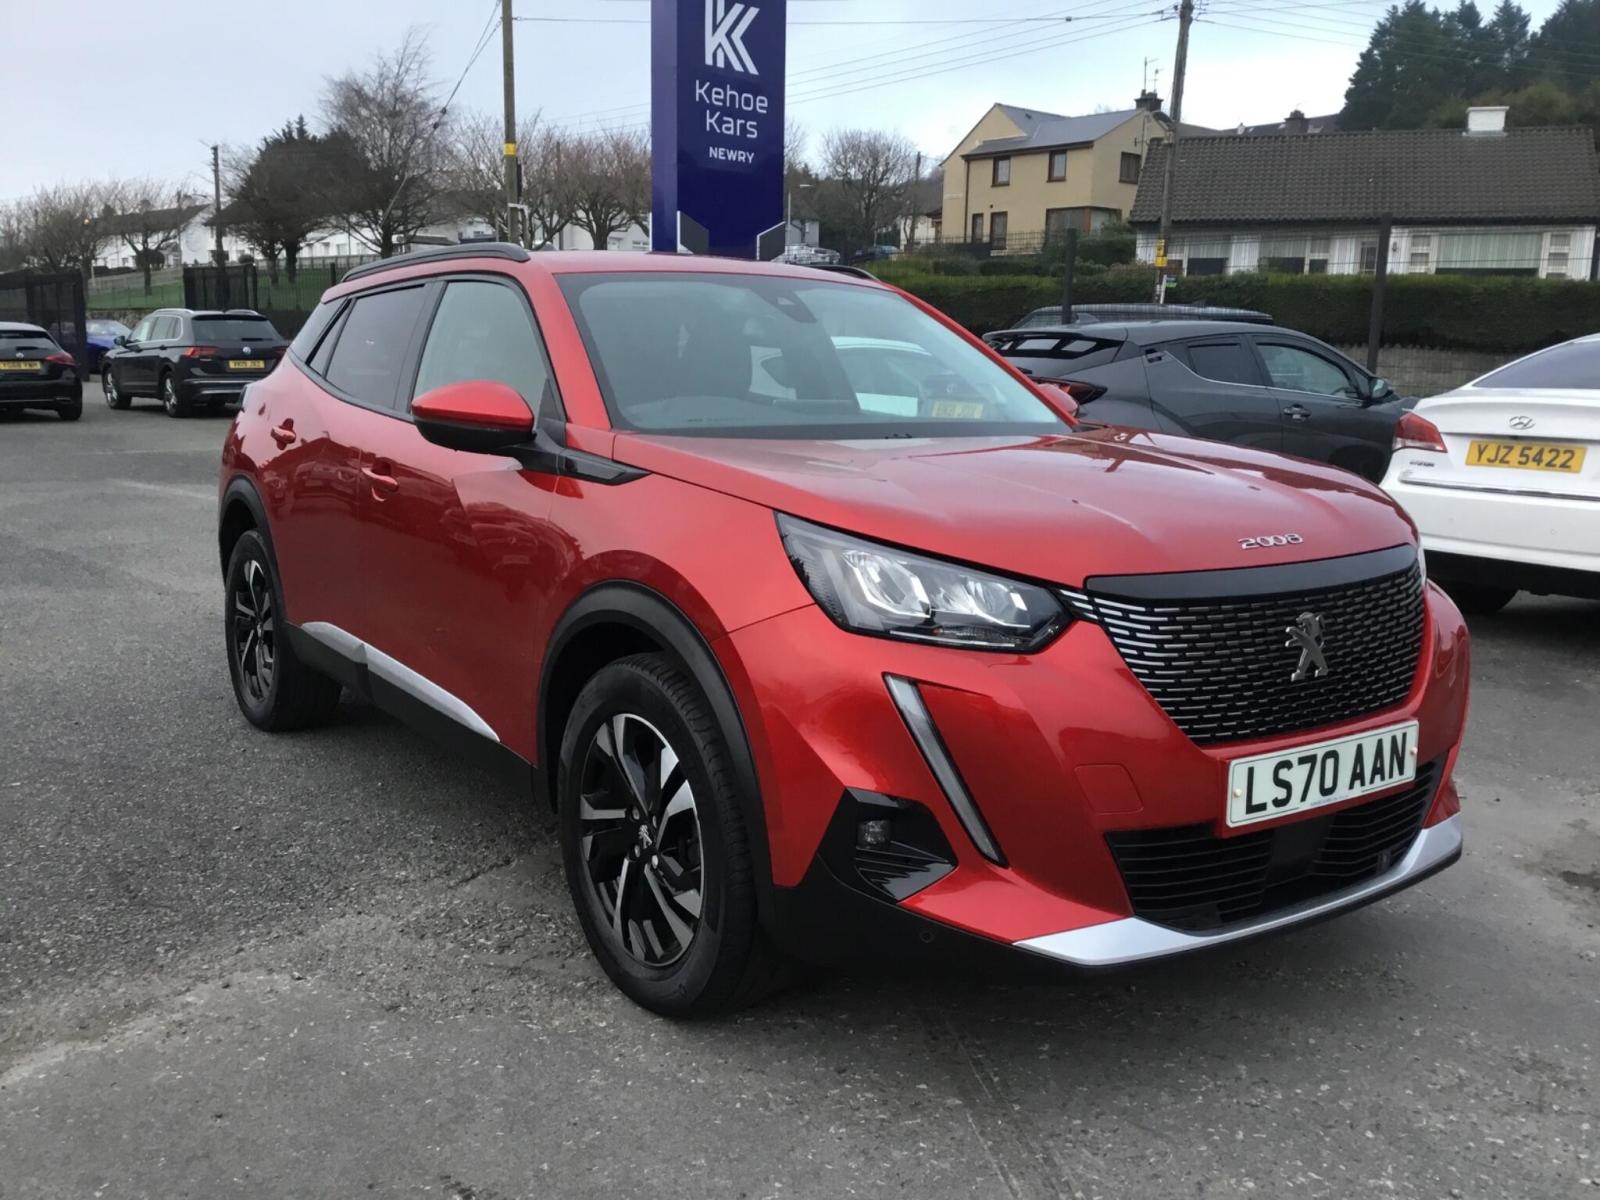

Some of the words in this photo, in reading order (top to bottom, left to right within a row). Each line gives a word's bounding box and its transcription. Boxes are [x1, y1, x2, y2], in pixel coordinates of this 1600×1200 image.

[695, 79, 768, 114] Kehoe
[706, 109, 758, 139] Kars
[709, 146, 755, 164] NEWRY
[1476, 444, 1512, 465] YJZ
[1517, 446, 1576, 470] 5422
[1237, 533, 1304, 549] 2008
[1245, 749, 1340, 815] LS70
[1348, 732, 1408, 790] AAN
